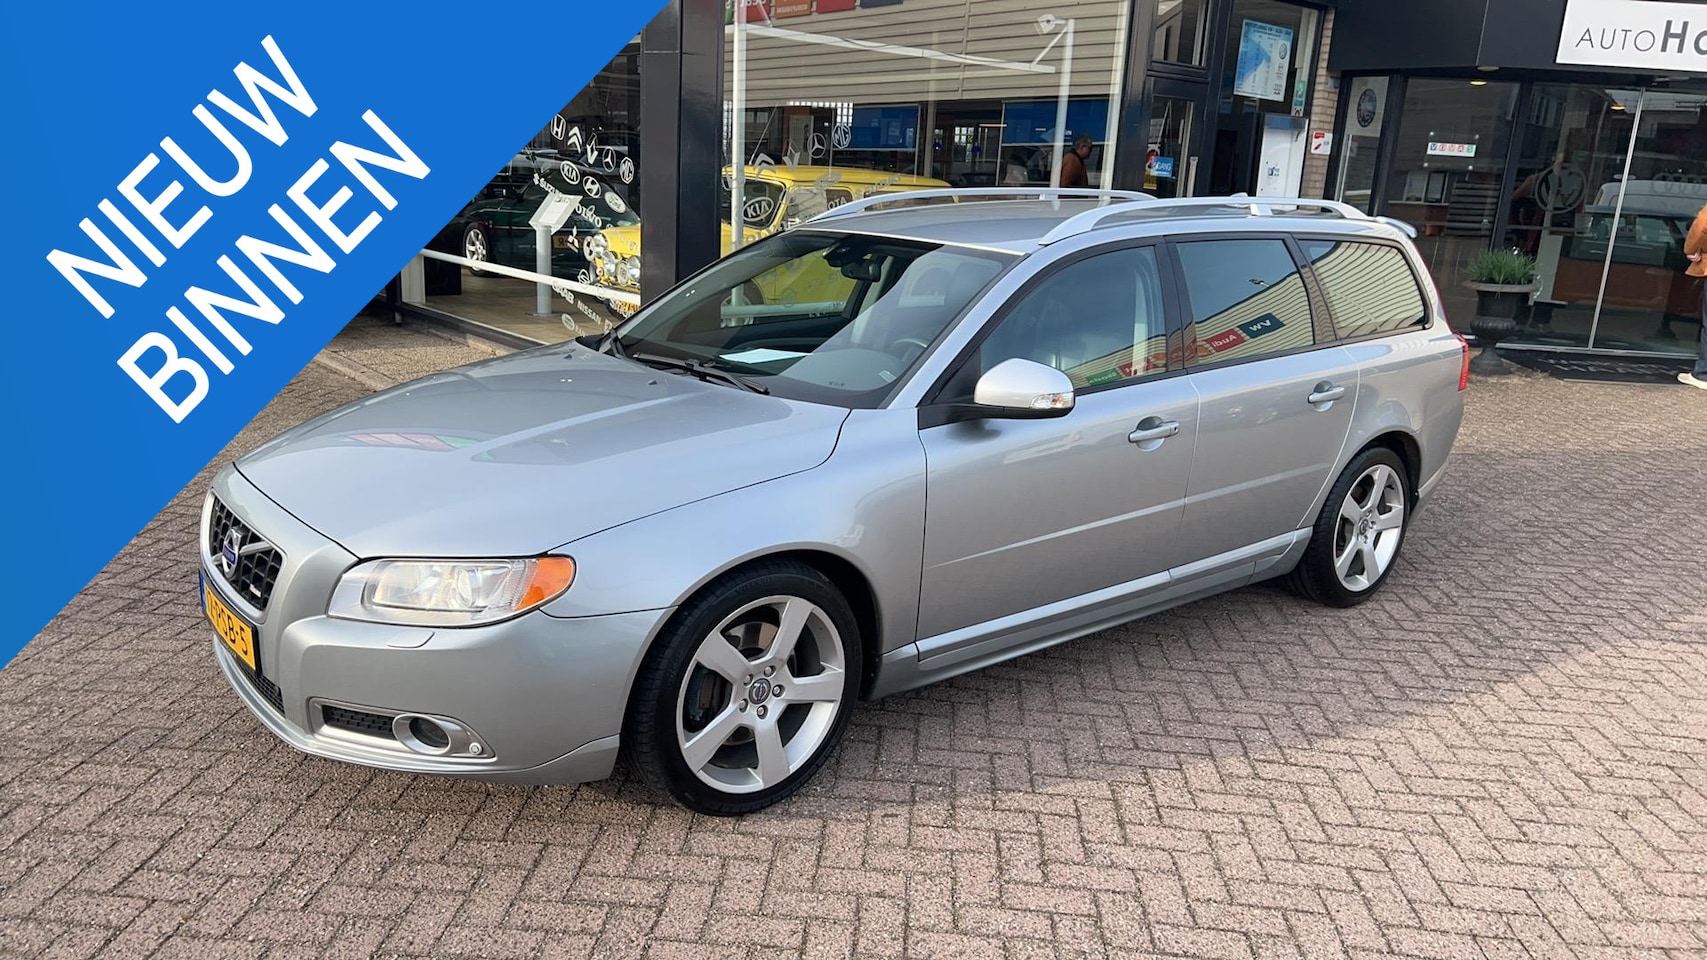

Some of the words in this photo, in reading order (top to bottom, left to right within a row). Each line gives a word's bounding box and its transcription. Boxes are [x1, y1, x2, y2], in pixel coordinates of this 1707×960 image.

[834, 126, 850, 147] MG
[564, 166, 577, 181] KIA
[539, 178, 562, 195] SUZU
[746, 202, 769, 218] KIA
[827, 196, 847, 210] OTA
[575, 203, 602, 227] OLVO
[577, 300, 601, 325] NISSAN
